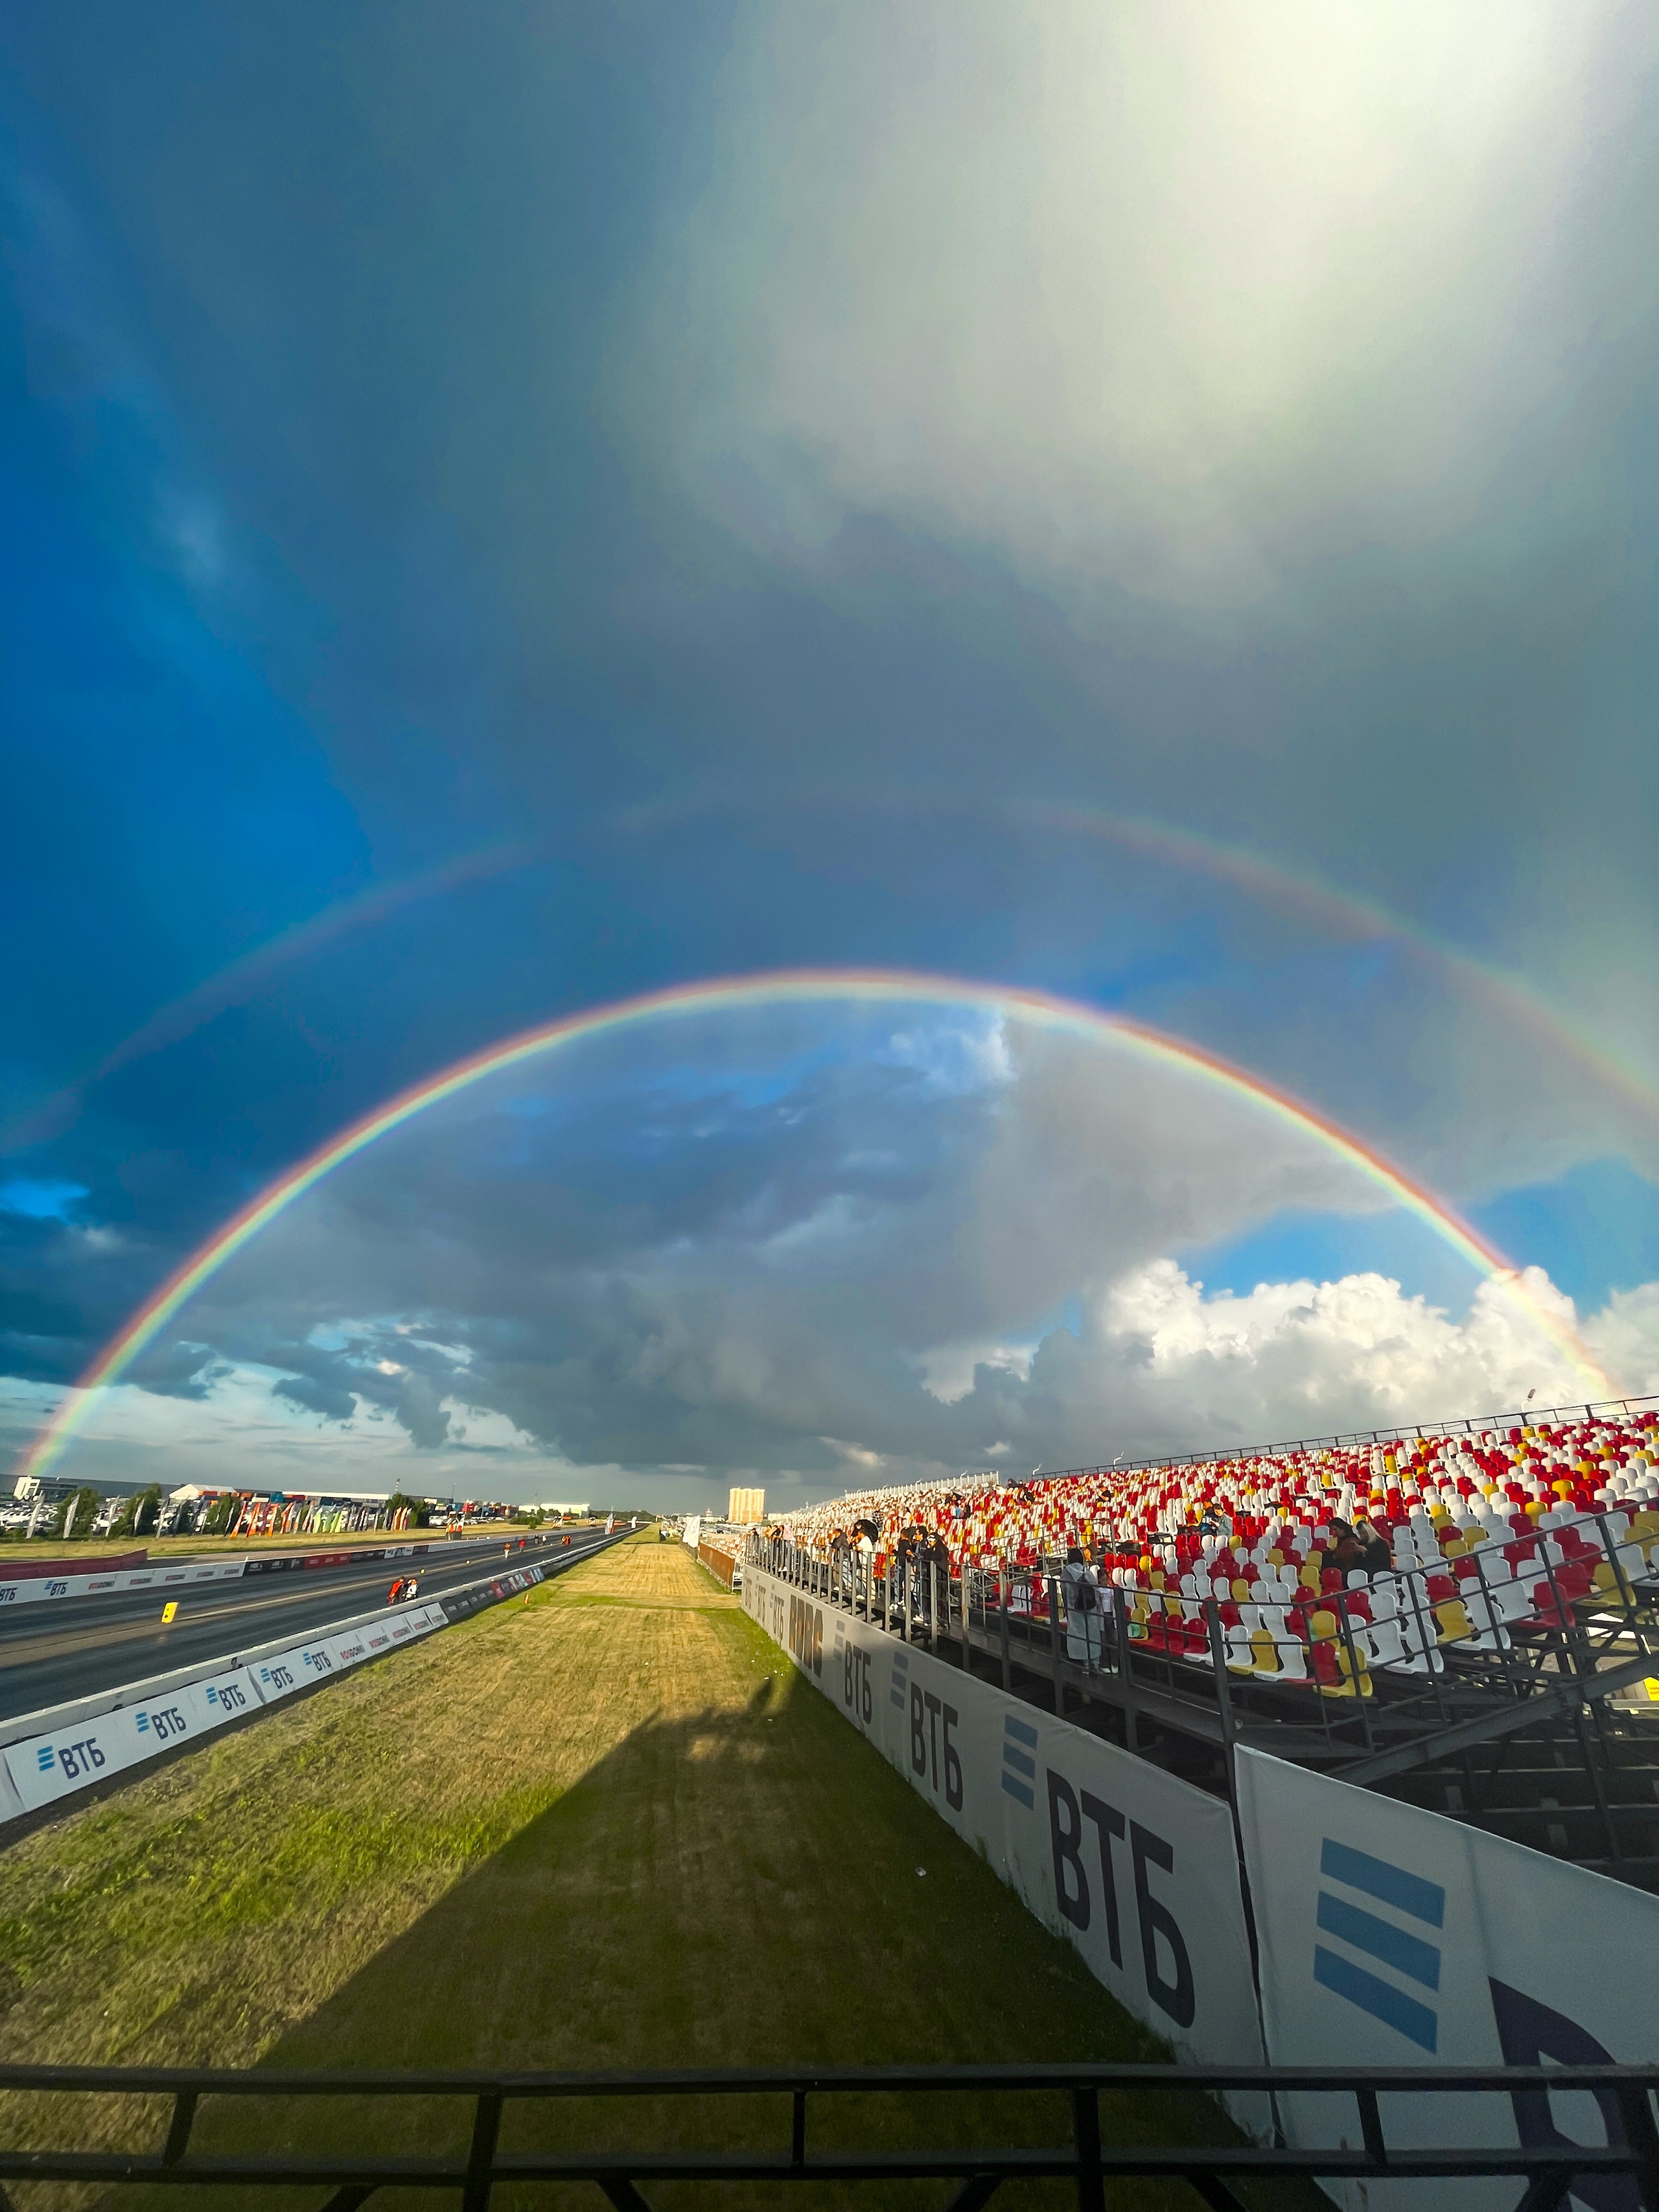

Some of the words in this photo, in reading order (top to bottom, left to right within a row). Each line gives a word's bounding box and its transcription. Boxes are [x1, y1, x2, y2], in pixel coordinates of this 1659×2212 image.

[50, 1582, 68, 1596] ВТБ
[270, 1666, 294, 1690] ВТБ
[311, 1651, 331, 1672] ВТБ
[218, 1684, 246, 1711] ВТБ
[845, 1640, 872, 1725] ВТБ
[151, 1707, 187, 1740] ВТБ
[58, 1737, 106, 1780] ВТБ
[911, 1681, 964, 1813] ВТБ
[1046, 1767, 1196, 2029] ВТБ
